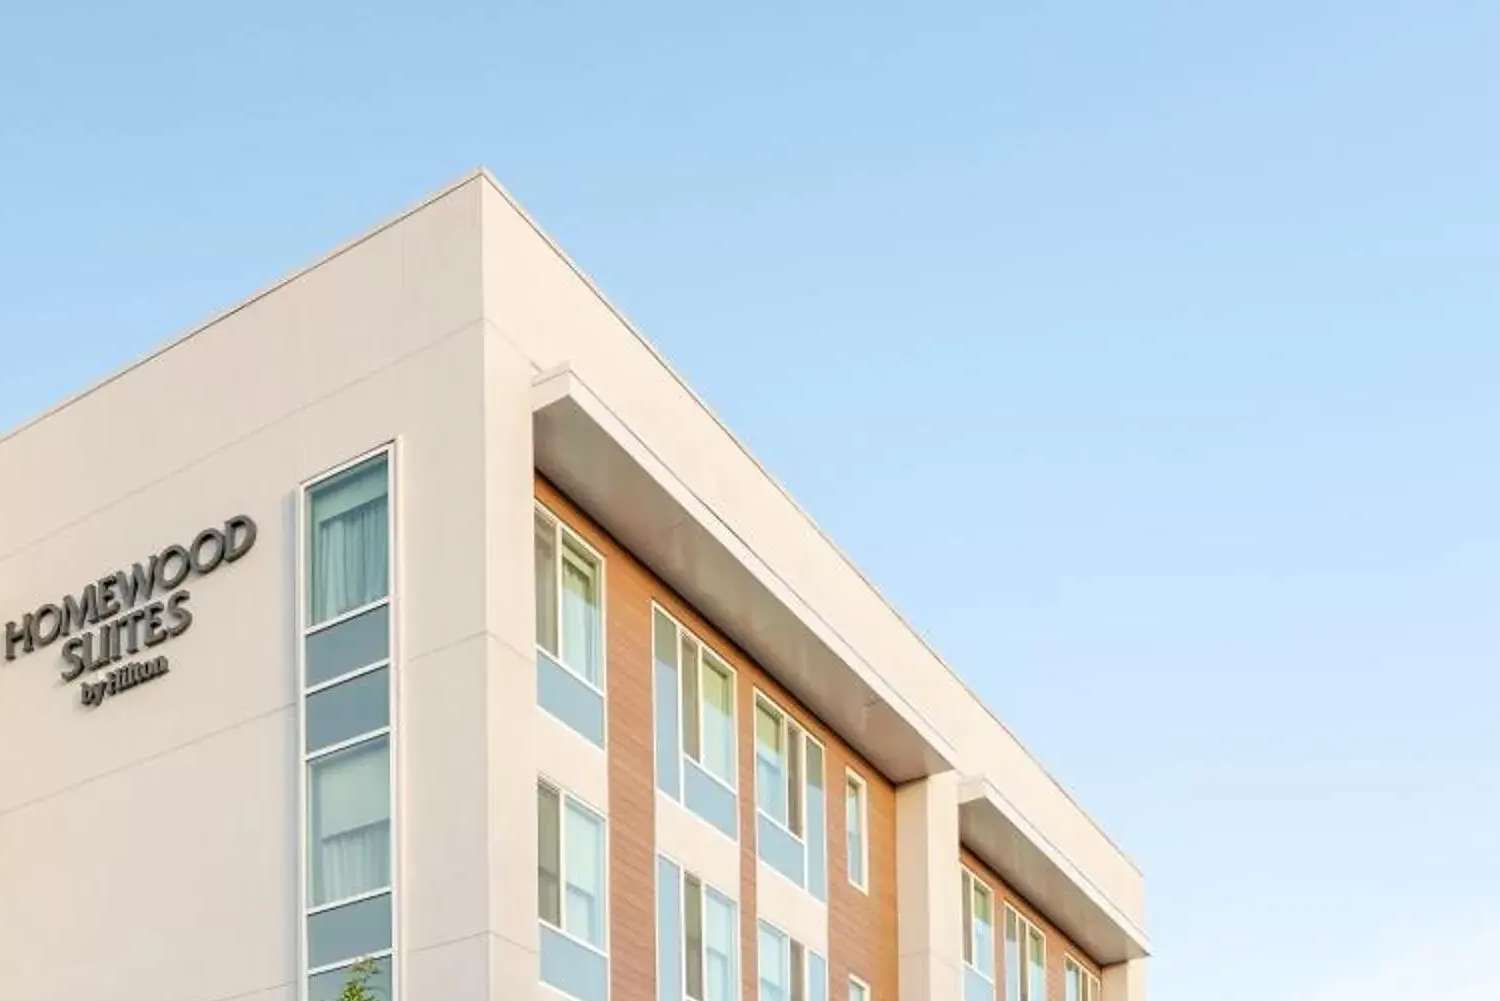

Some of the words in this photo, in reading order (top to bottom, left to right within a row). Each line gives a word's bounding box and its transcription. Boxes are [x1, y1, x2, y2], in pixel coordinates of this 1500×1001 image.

[5, 514, 258, 661] HOMEWOOD
[60, 589, 194, 682] SUITES
[81, 681, 107, 707] by
[106, 656, 170, 697] Hilton
